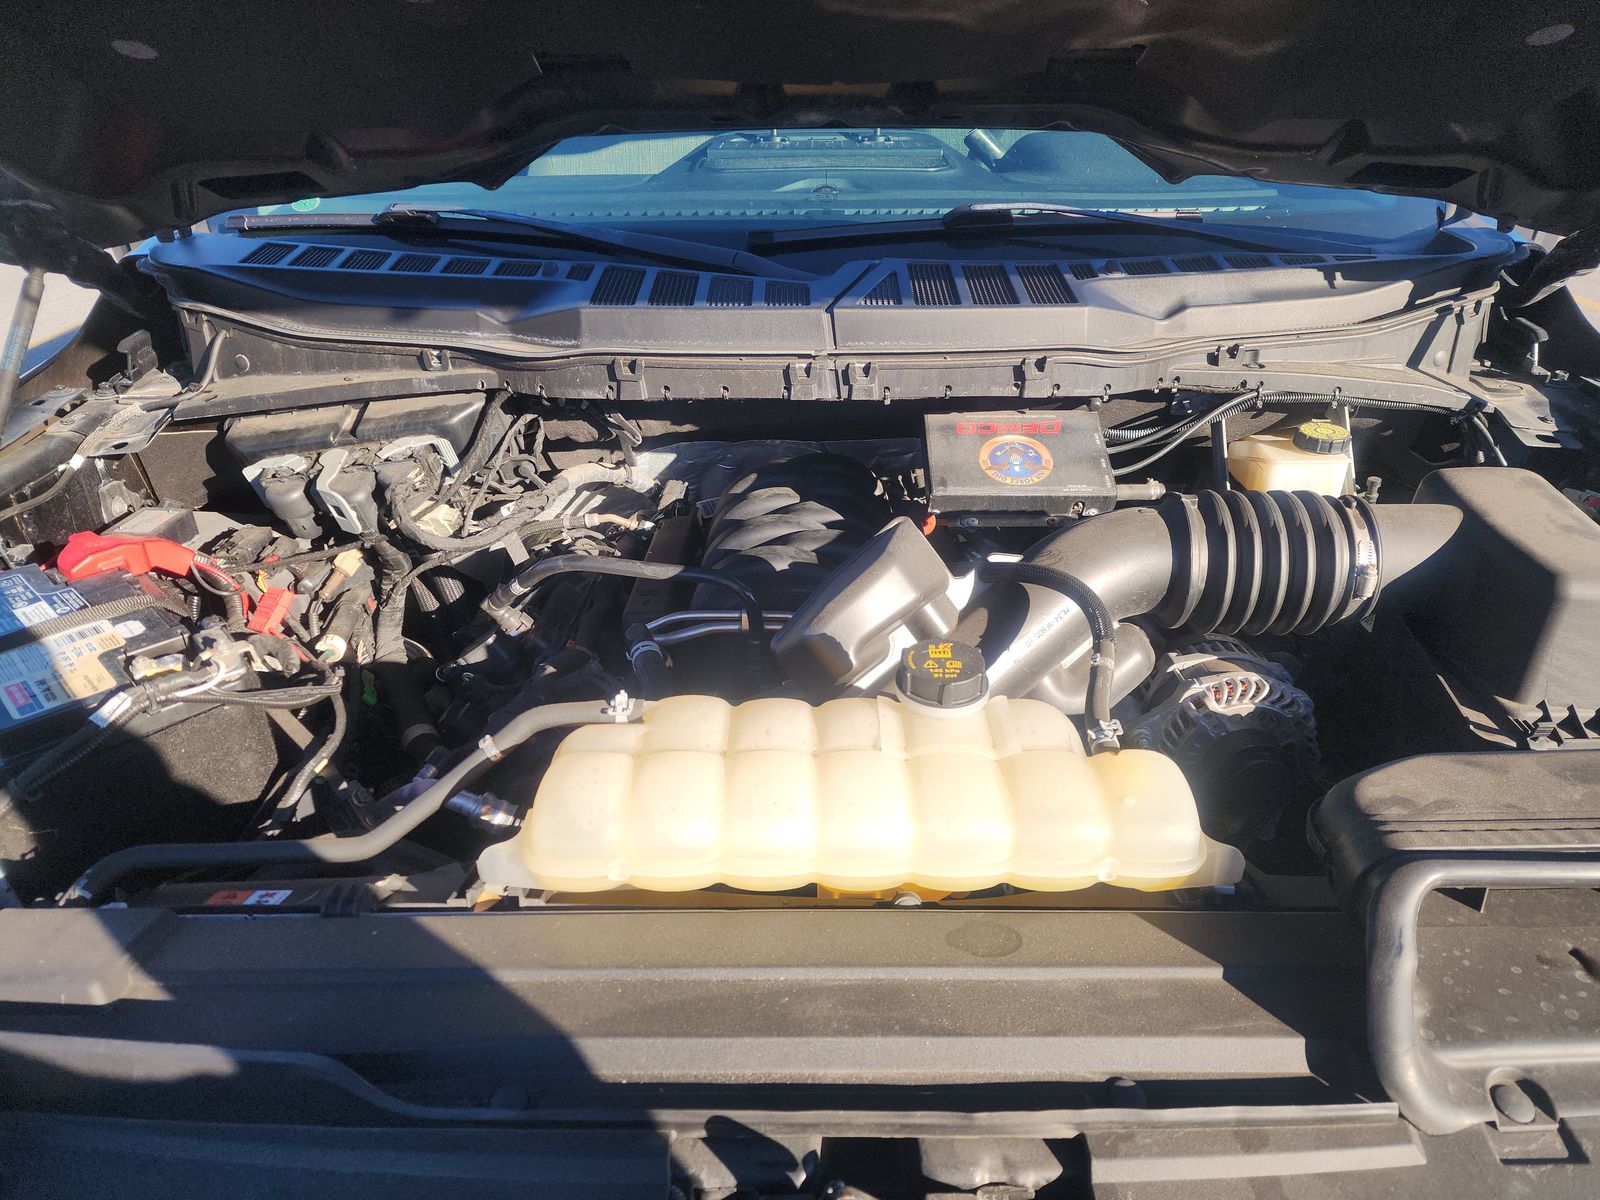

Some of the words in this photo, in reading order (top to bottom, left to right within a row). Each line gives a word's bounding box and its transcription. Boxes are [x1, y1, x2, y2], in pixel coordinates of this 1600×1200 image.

[956, 420, 1061, 434] DEMCO
[990, 471, 1008, 482] ONE
[1009, 476, 1034, 485] FORCE
